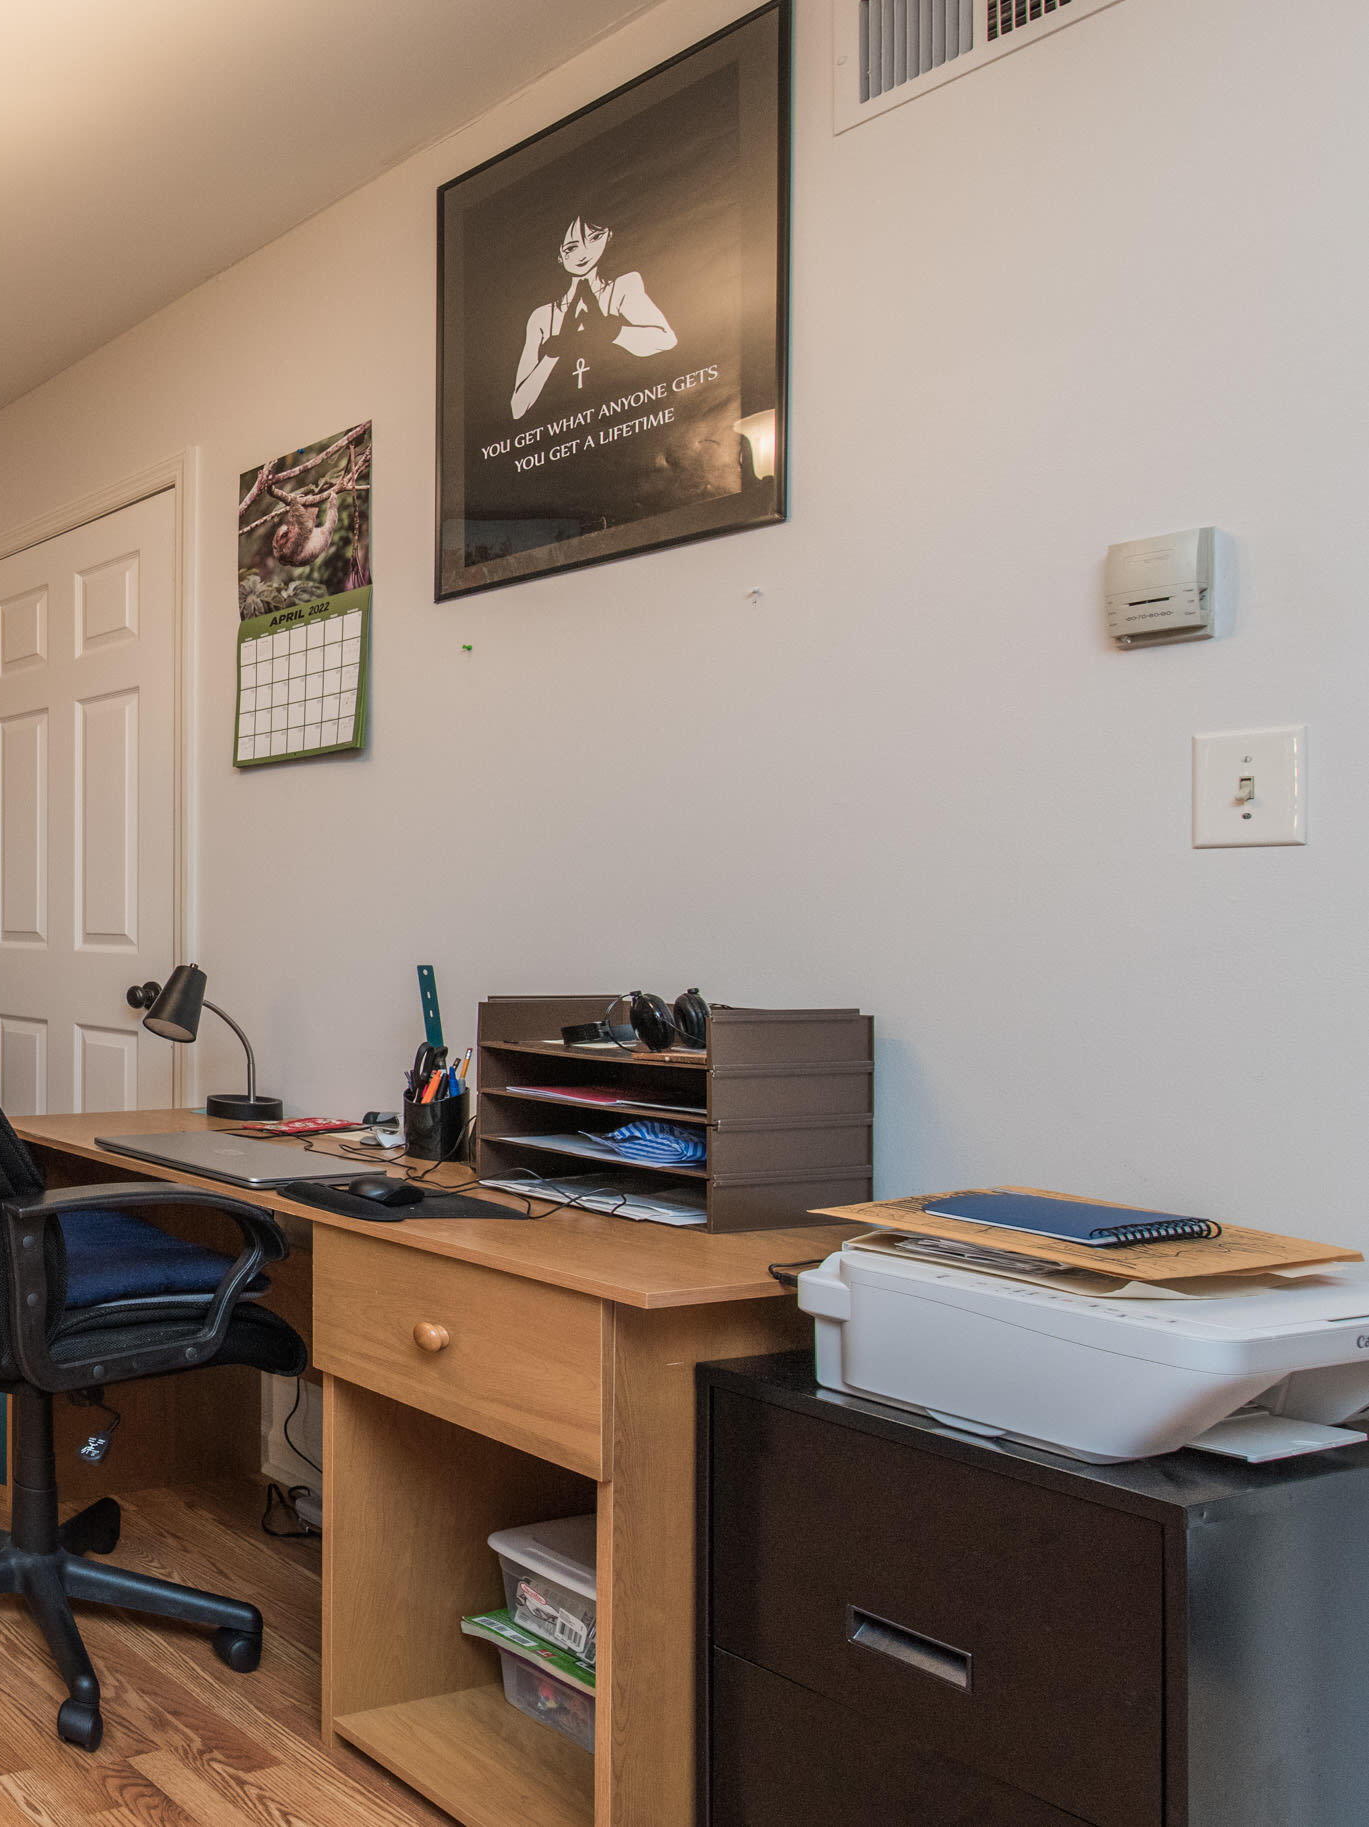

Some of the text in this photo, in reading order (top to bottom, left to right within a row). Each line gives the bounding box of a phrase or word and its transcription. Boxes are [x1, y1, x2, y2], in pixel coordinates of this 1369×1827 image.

[481, 364, 719, 460] YOU GET WHAT ANYONE GETS
[514, 407, 675, 473] YOU GET A LIFETIME
[269, 608, 305, 627] APRIL
[308, 601, 330, 617] 2022
